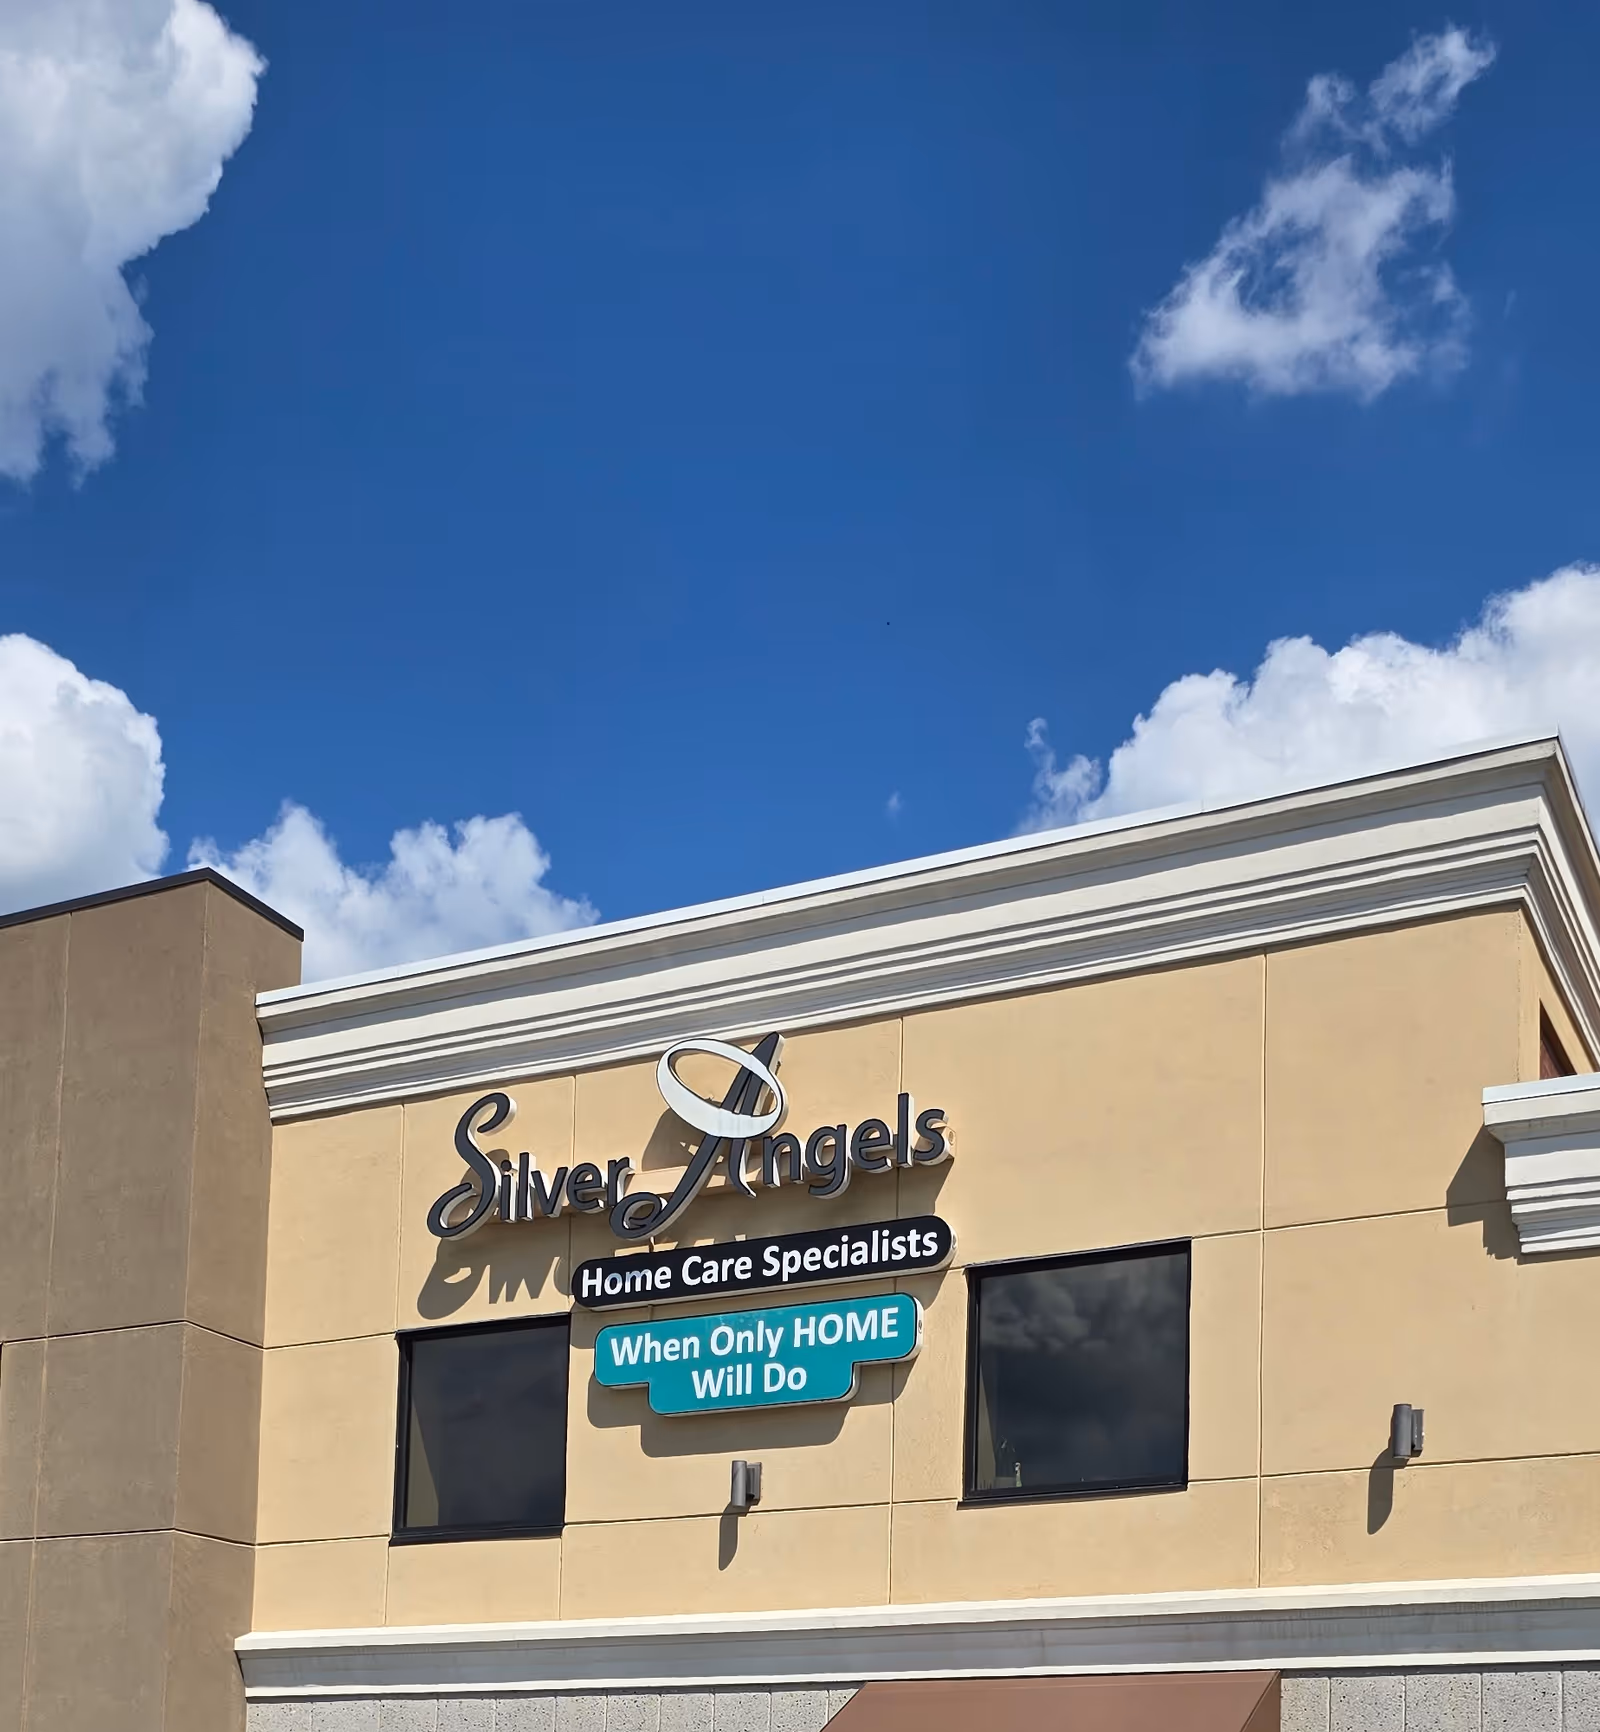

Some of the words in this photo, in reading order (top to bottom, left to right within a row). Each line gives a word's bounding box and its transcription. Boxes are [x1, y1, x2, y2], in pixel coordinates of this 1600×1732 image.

[427, 1092, 633, 1239] Silver
[609, 1032, 948, 1239] Angels
[581, 1267, 672, 1298] Home
[682, 1254, 752, 1286] Care
[762, 1228, 939, 1282] Specialists
[610, 1334, 700, 1367] When
[710, 1320, 785, 1358] Only
[794, 1307, 899, 1347] HOME
[691, 1363, 752, 1399] Will
[763, 1361, 808, 1393] Do
